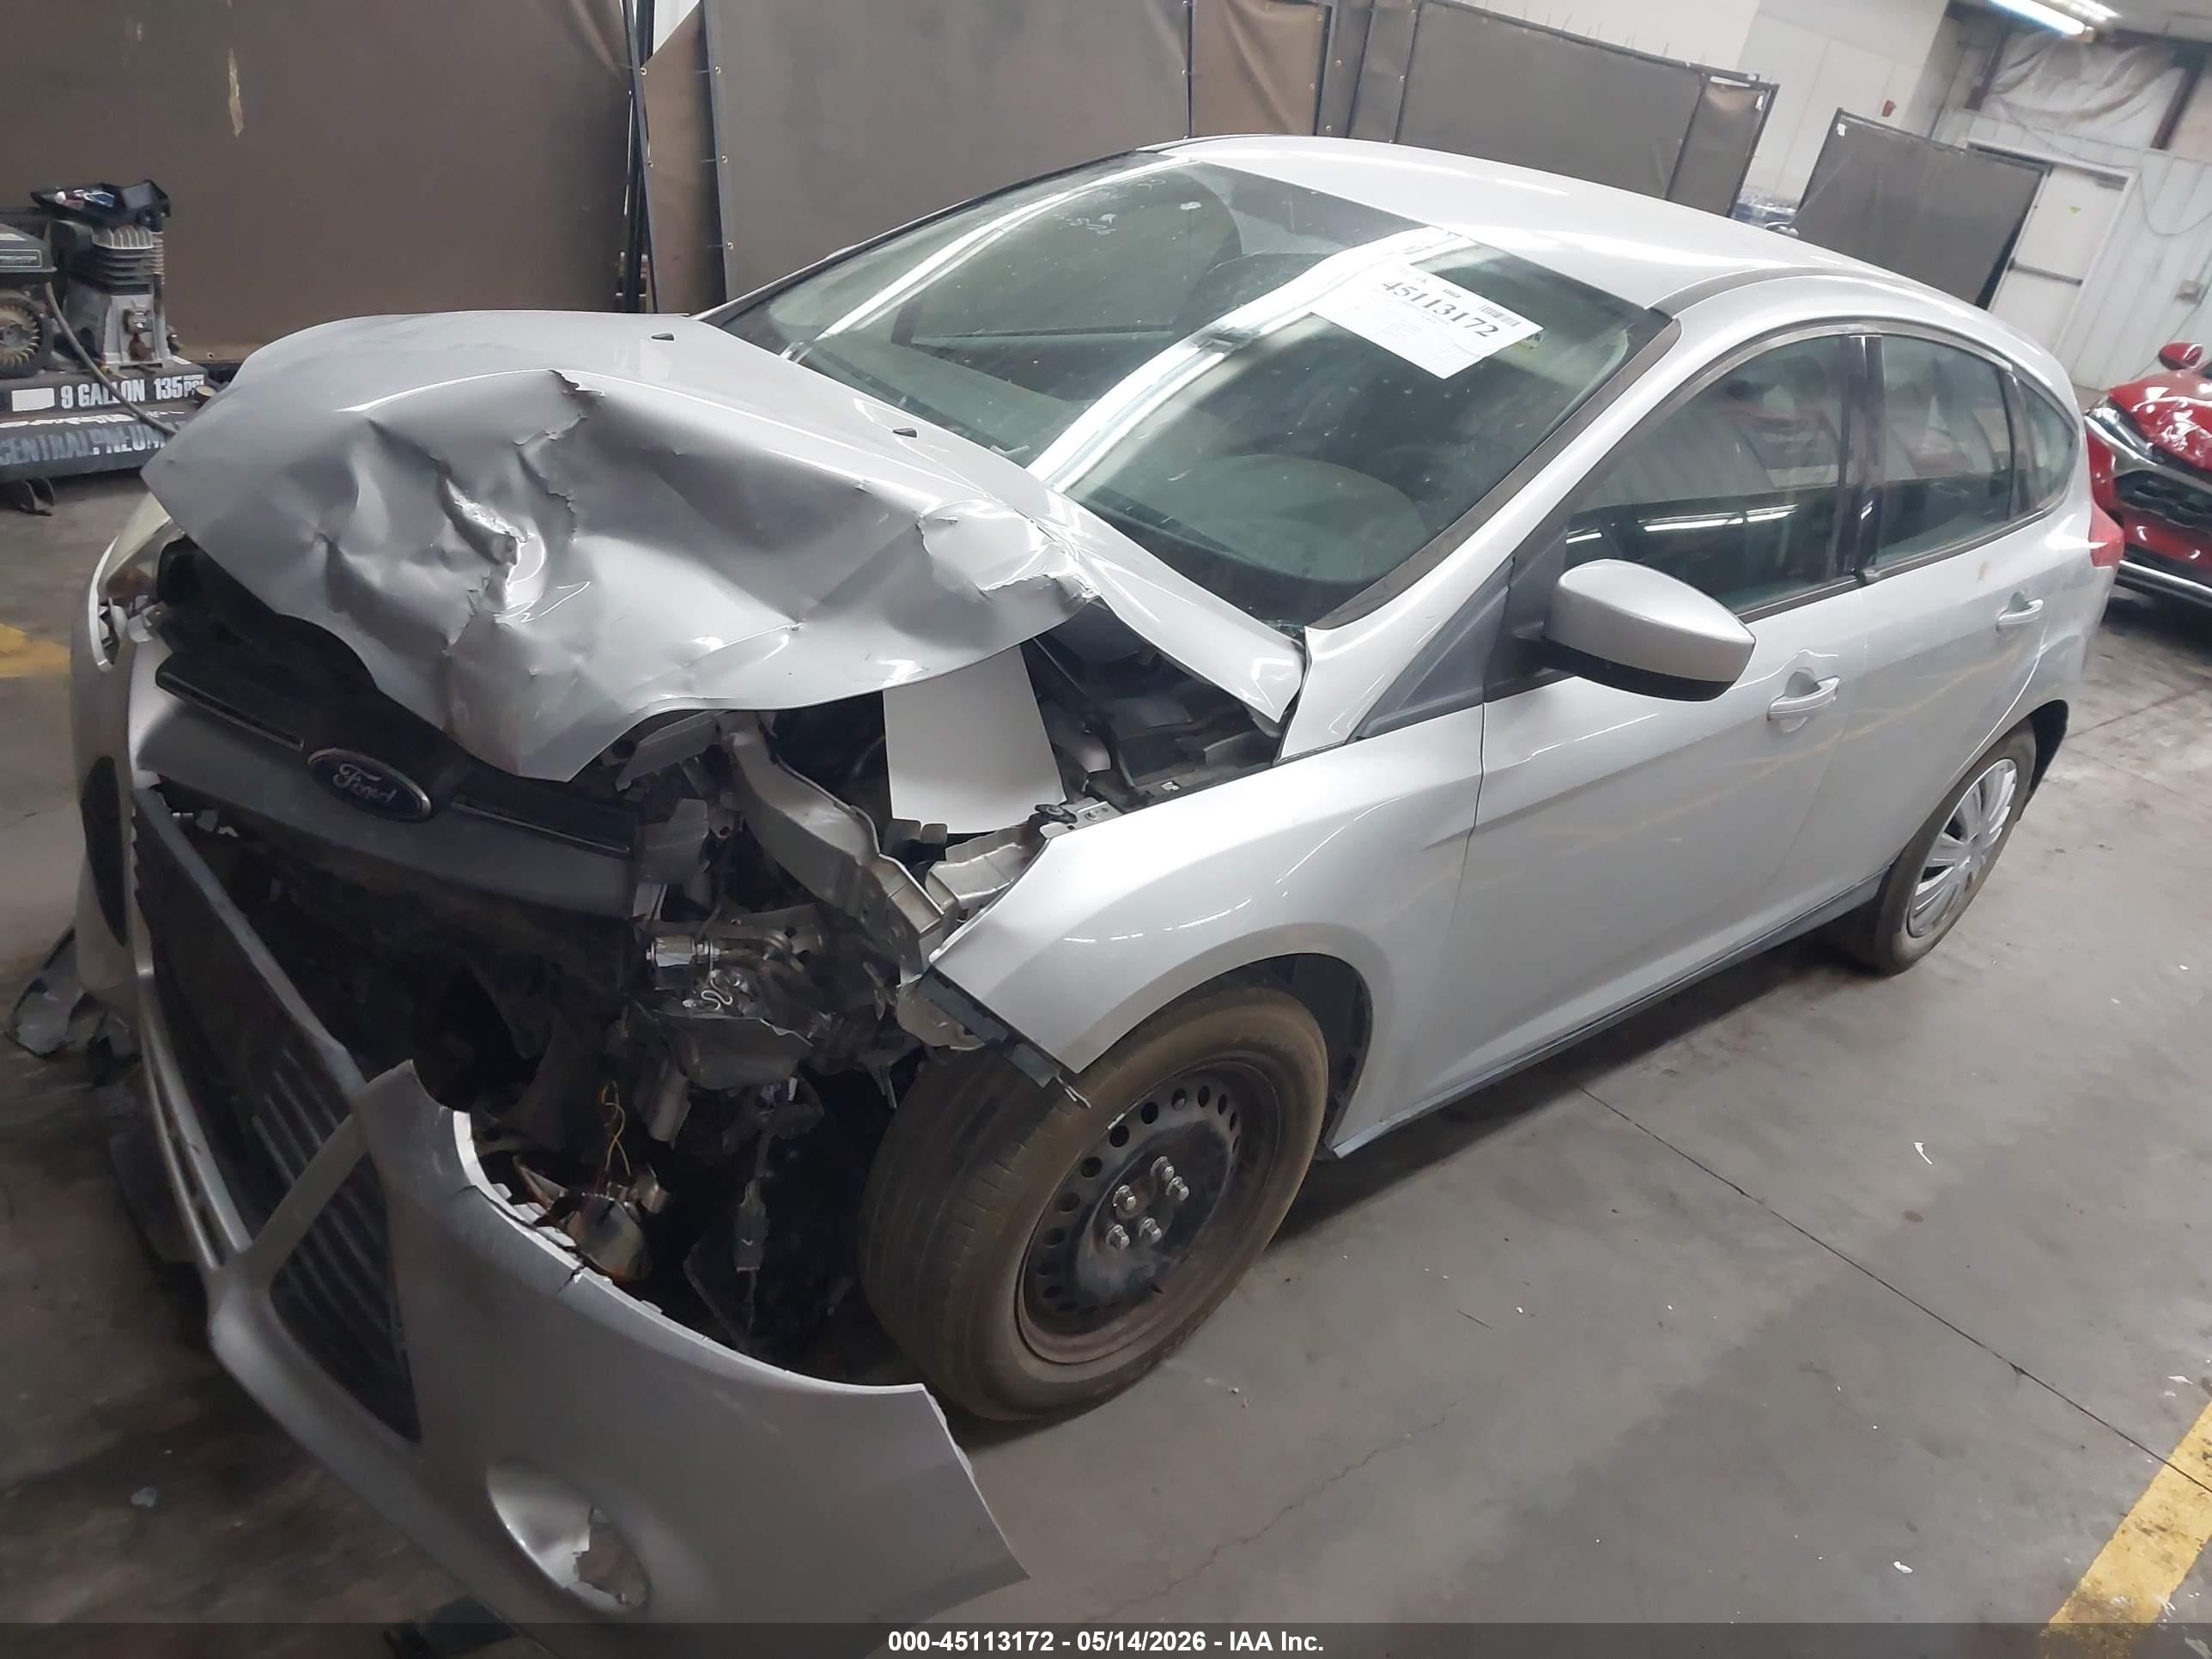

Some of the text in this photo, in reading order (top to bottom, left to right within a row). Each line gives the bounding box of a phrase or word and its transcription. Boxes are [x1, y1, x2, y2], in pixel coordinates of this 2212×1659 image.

[1382, 282, 1499, 337] 45113172
[60, 385, 74, 409] 9
[154, 376, 183, 400] 135
[333, 763, 397, 804] Ford
